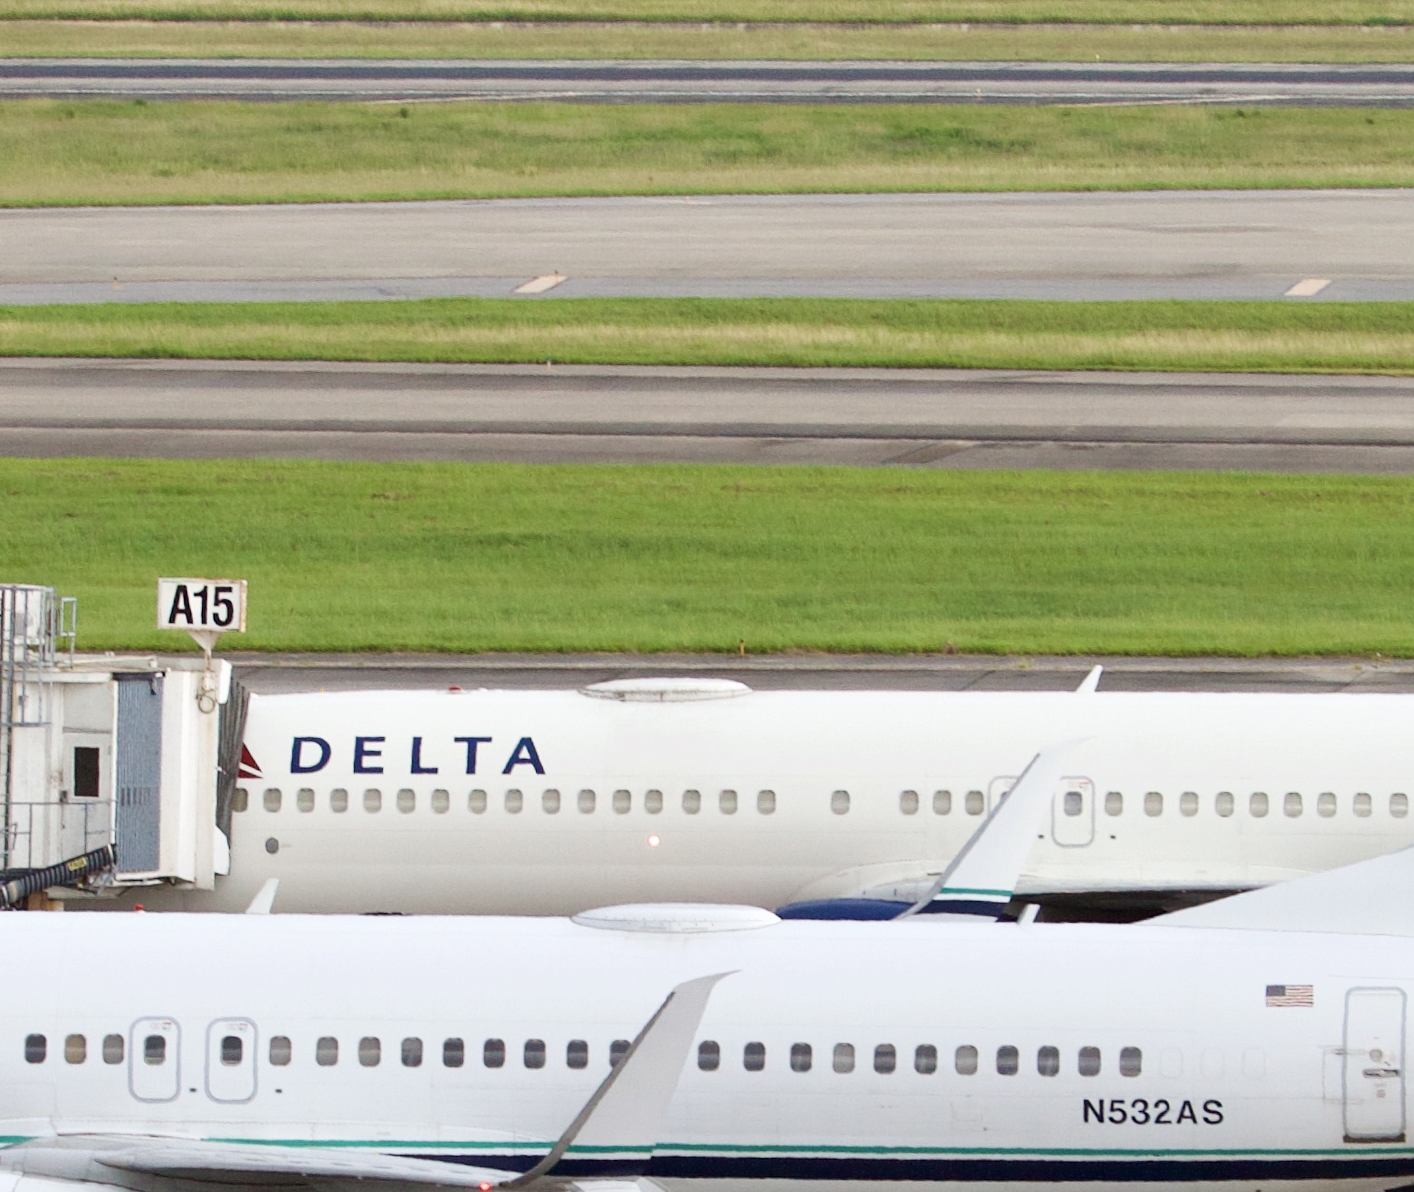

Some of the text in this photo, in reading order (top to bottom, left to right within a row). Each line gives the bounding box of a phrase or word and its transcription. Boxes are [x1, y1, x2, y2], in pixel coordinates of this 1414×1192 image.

[168, 584, 234, 627] A15
[290, 736, 546, 775] DELTA
[1082, 1098, 1224, 1126] N532AS
